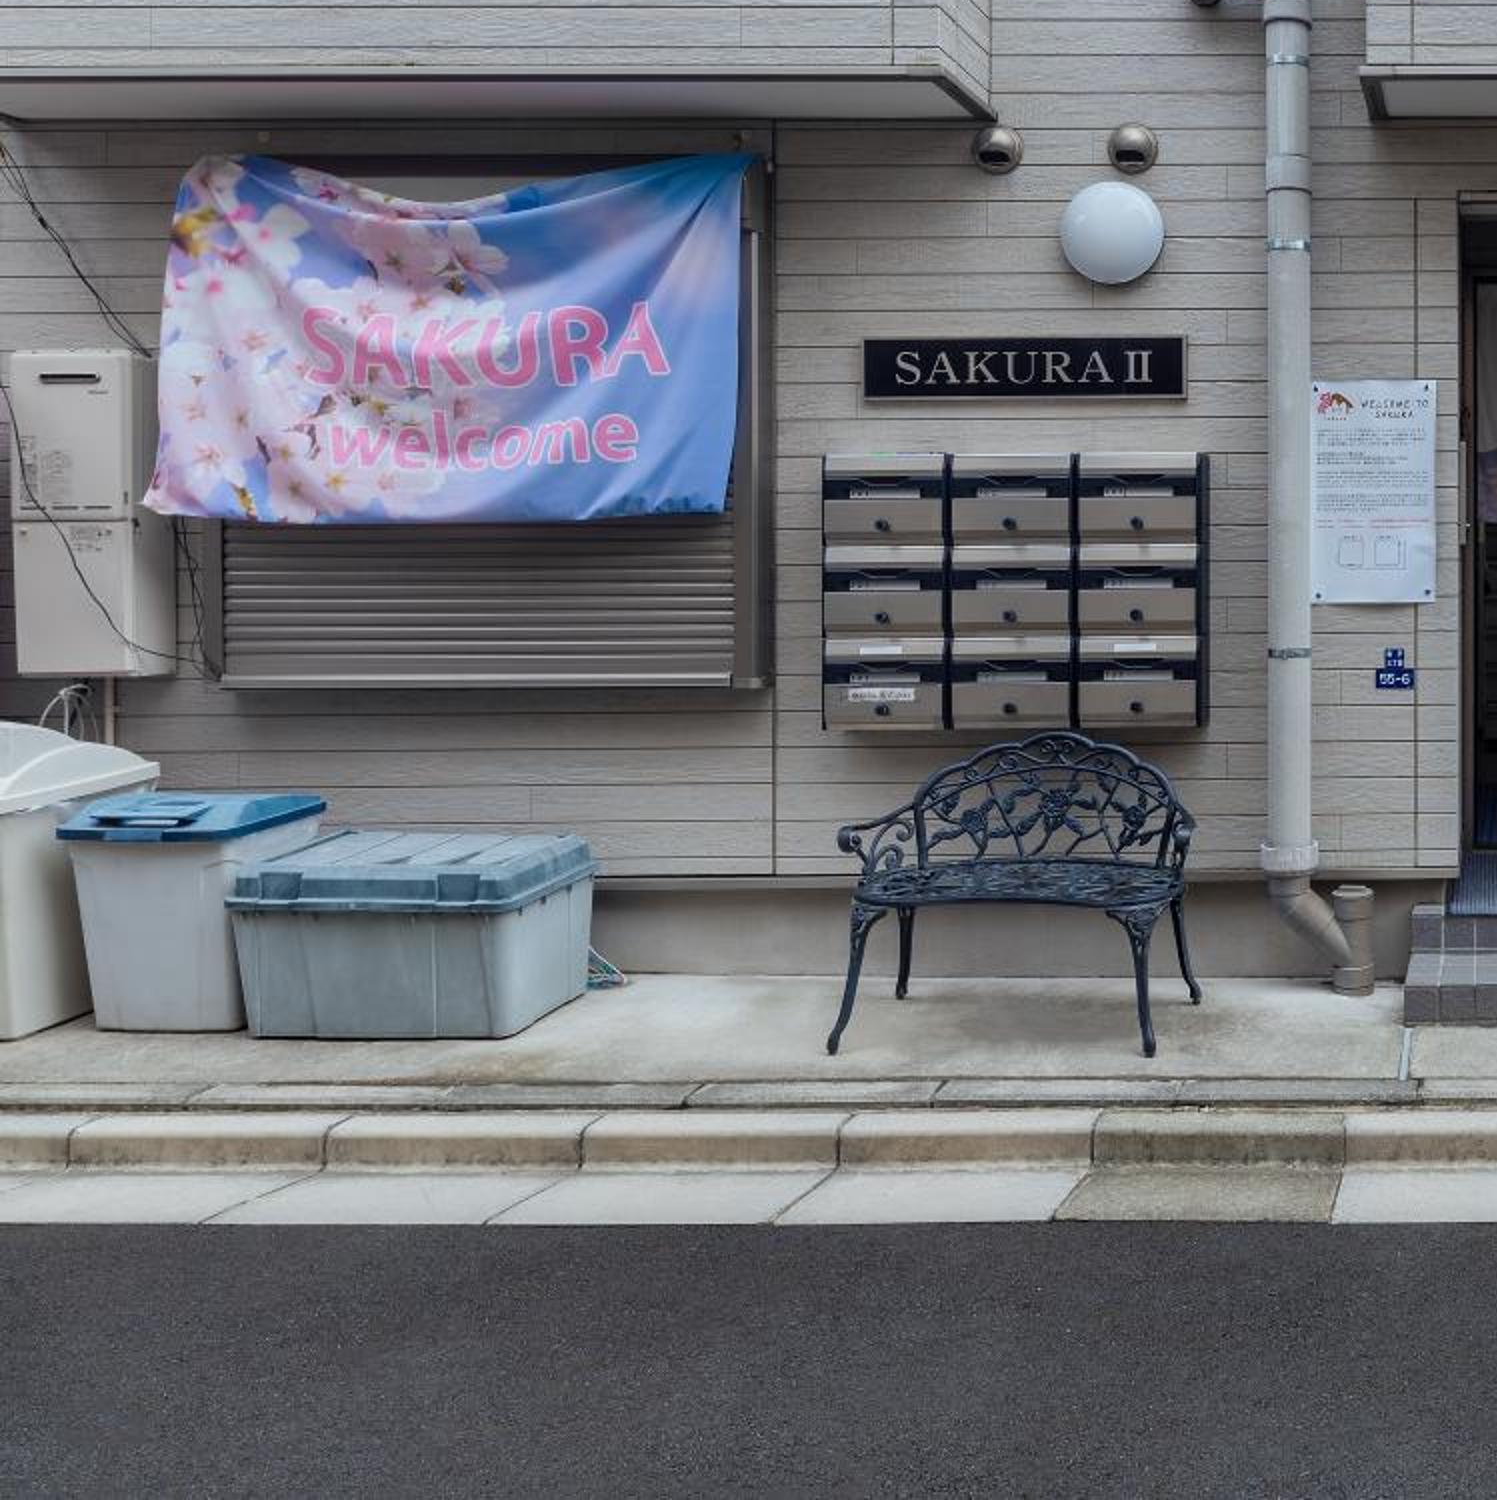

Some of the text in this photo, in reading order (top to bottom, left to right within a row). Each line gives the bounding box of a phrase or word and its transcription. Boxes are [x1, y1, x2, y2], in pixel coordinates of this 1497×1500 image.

[300, 301, 671, 388] SAKURA
[895, 351, 1153, 385] SAKURA II
[329, 409, 639, 472] welcome
